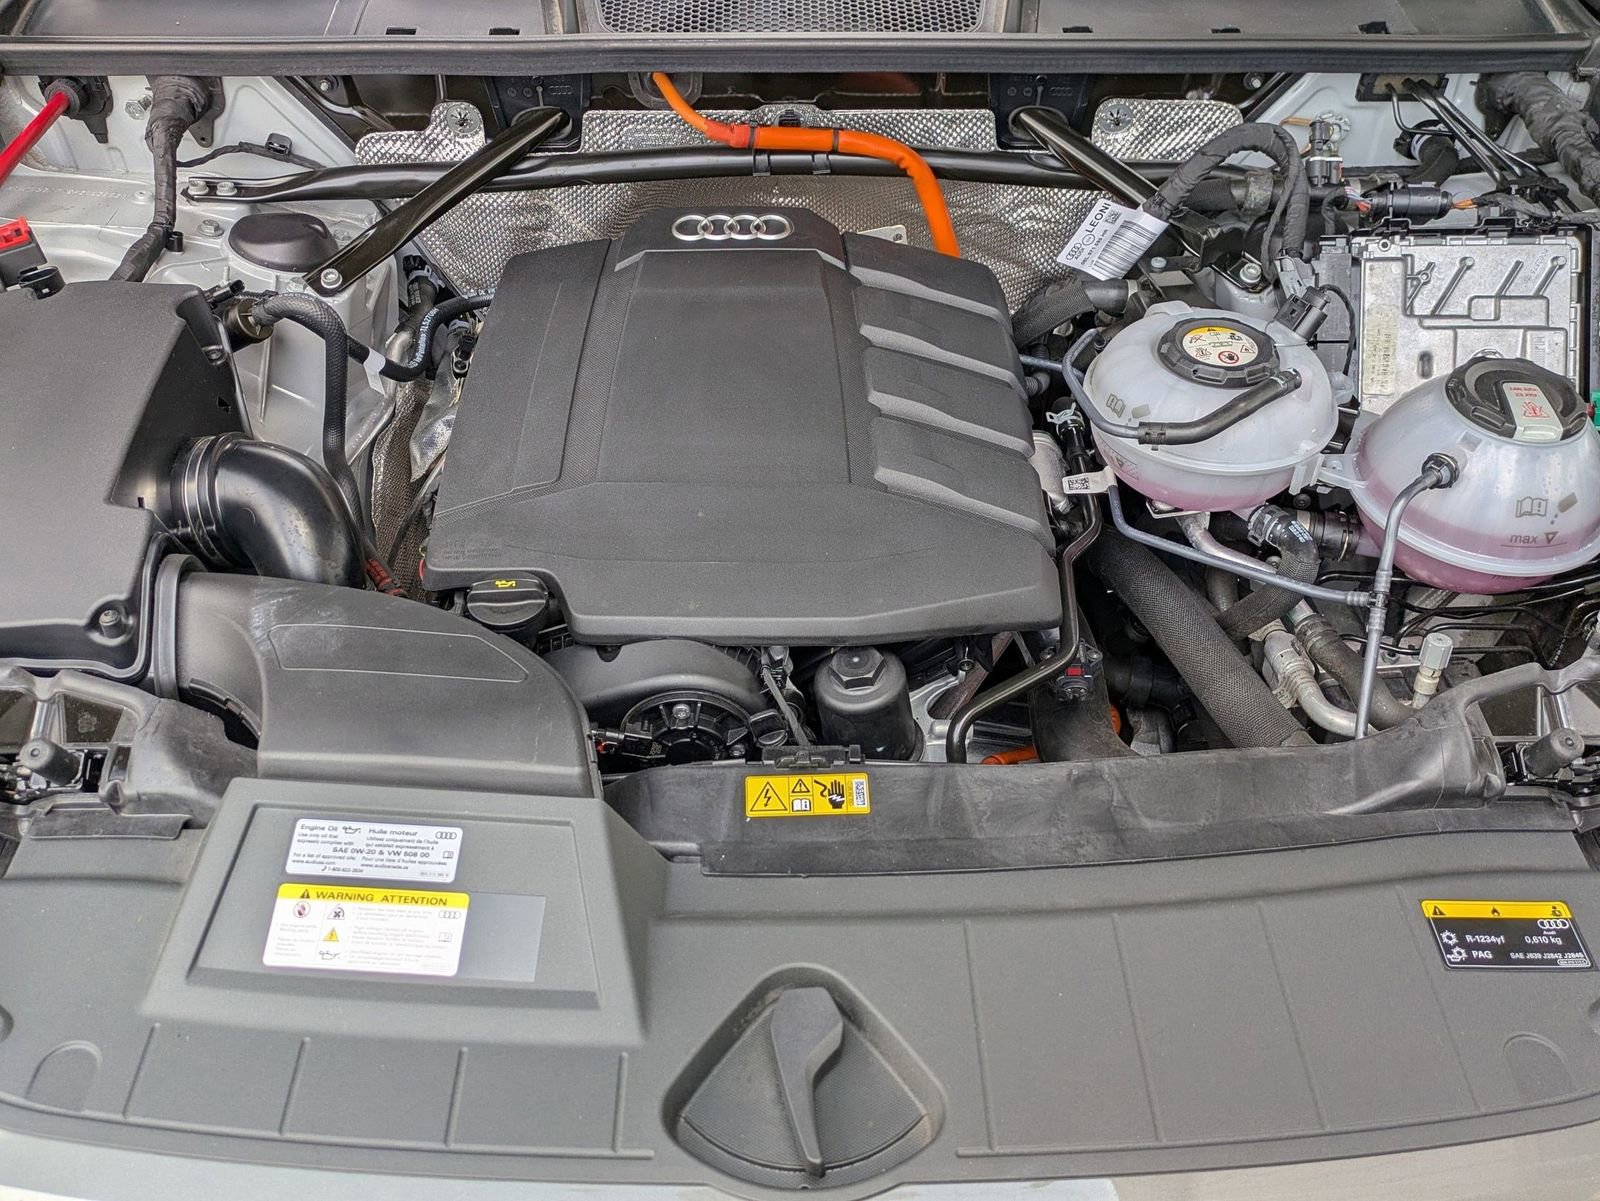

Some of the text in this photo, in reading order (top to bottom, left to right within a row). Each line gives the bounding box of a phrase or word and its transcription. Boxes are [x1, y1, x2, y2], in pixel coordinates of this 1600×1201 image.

[1085, 202, 1111, 233] LEONI
[1510, 533, 1538, 544] max
[300, 823, 326, 832] Engine
[332, 846, 349, 854] SAE
[350, 847, 376, 855] 0W-20
[387, 849, 402, 857] VW
[316, 890, 448, 906] WARNING ATTENTION
[1465, 934, 1505, 945] R-1234yf
[1550, 935, 1562, 945] kg
[1472, 950, 1493, 959] PAG
